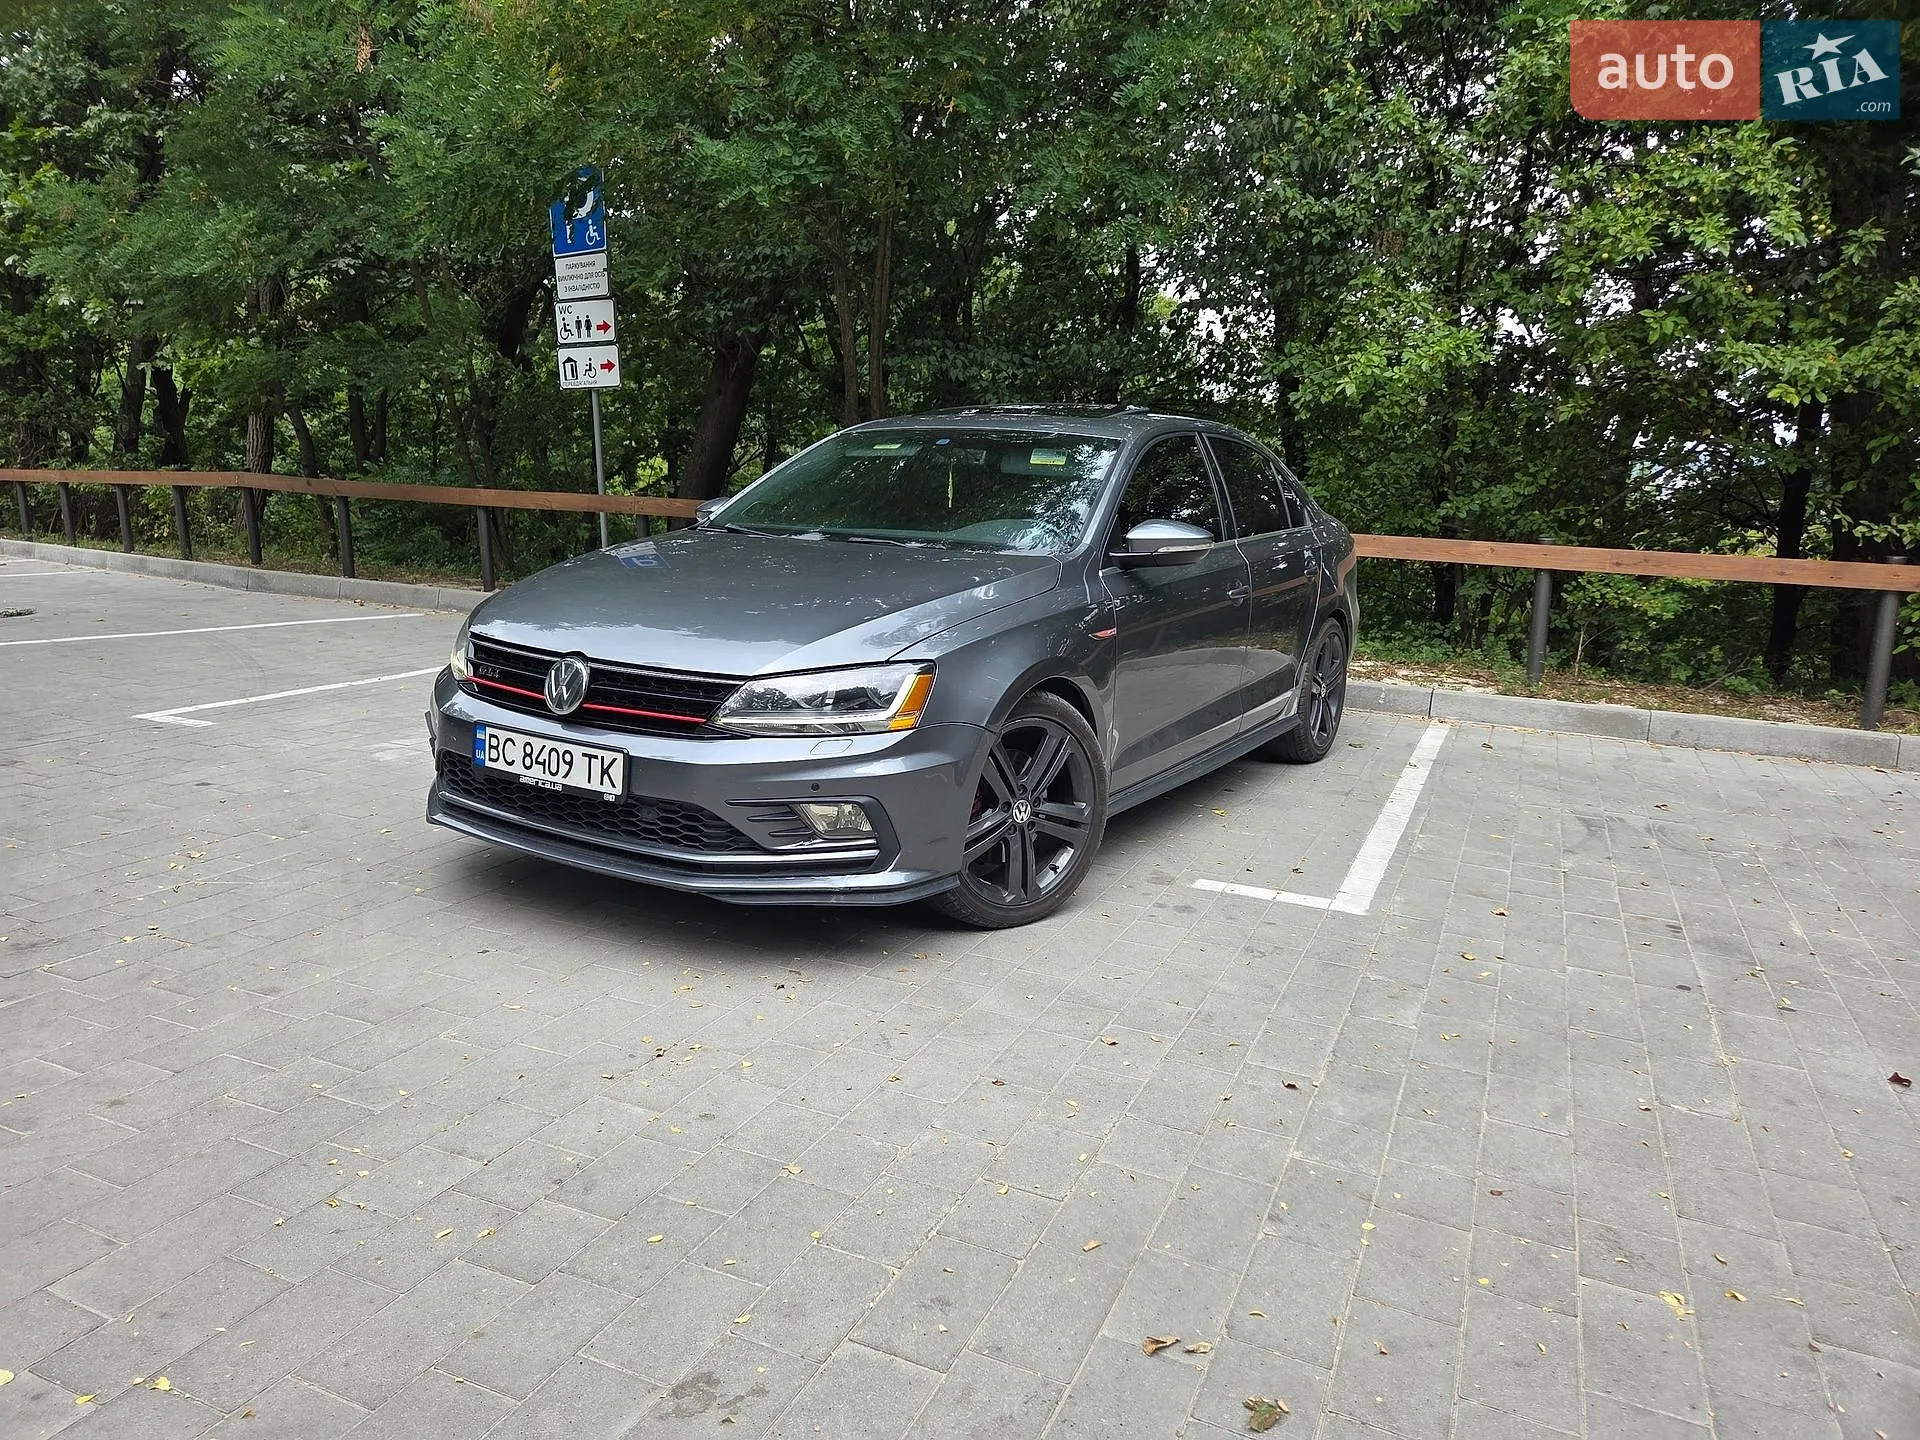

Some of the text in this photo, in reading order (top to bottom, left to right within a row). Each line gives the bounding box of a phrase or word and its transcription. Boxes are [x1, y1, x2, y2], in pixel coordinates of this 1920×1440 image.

[565, 260, 595, 270] ПАРКУВАННЯ
[558, 273, 583, 283] ВИКЛЮЧНО
[584, 271, 593, 280] ДЛЯ
[568, 282, 600, 292] ІНВАЛІДНІСТЮ
[558, 305, 572, 314] WC
[475, 750, 485, 760] UA
[488, 734, 618, 789] BC 8409 TK
[519, 776, 563, 791] america.ua
